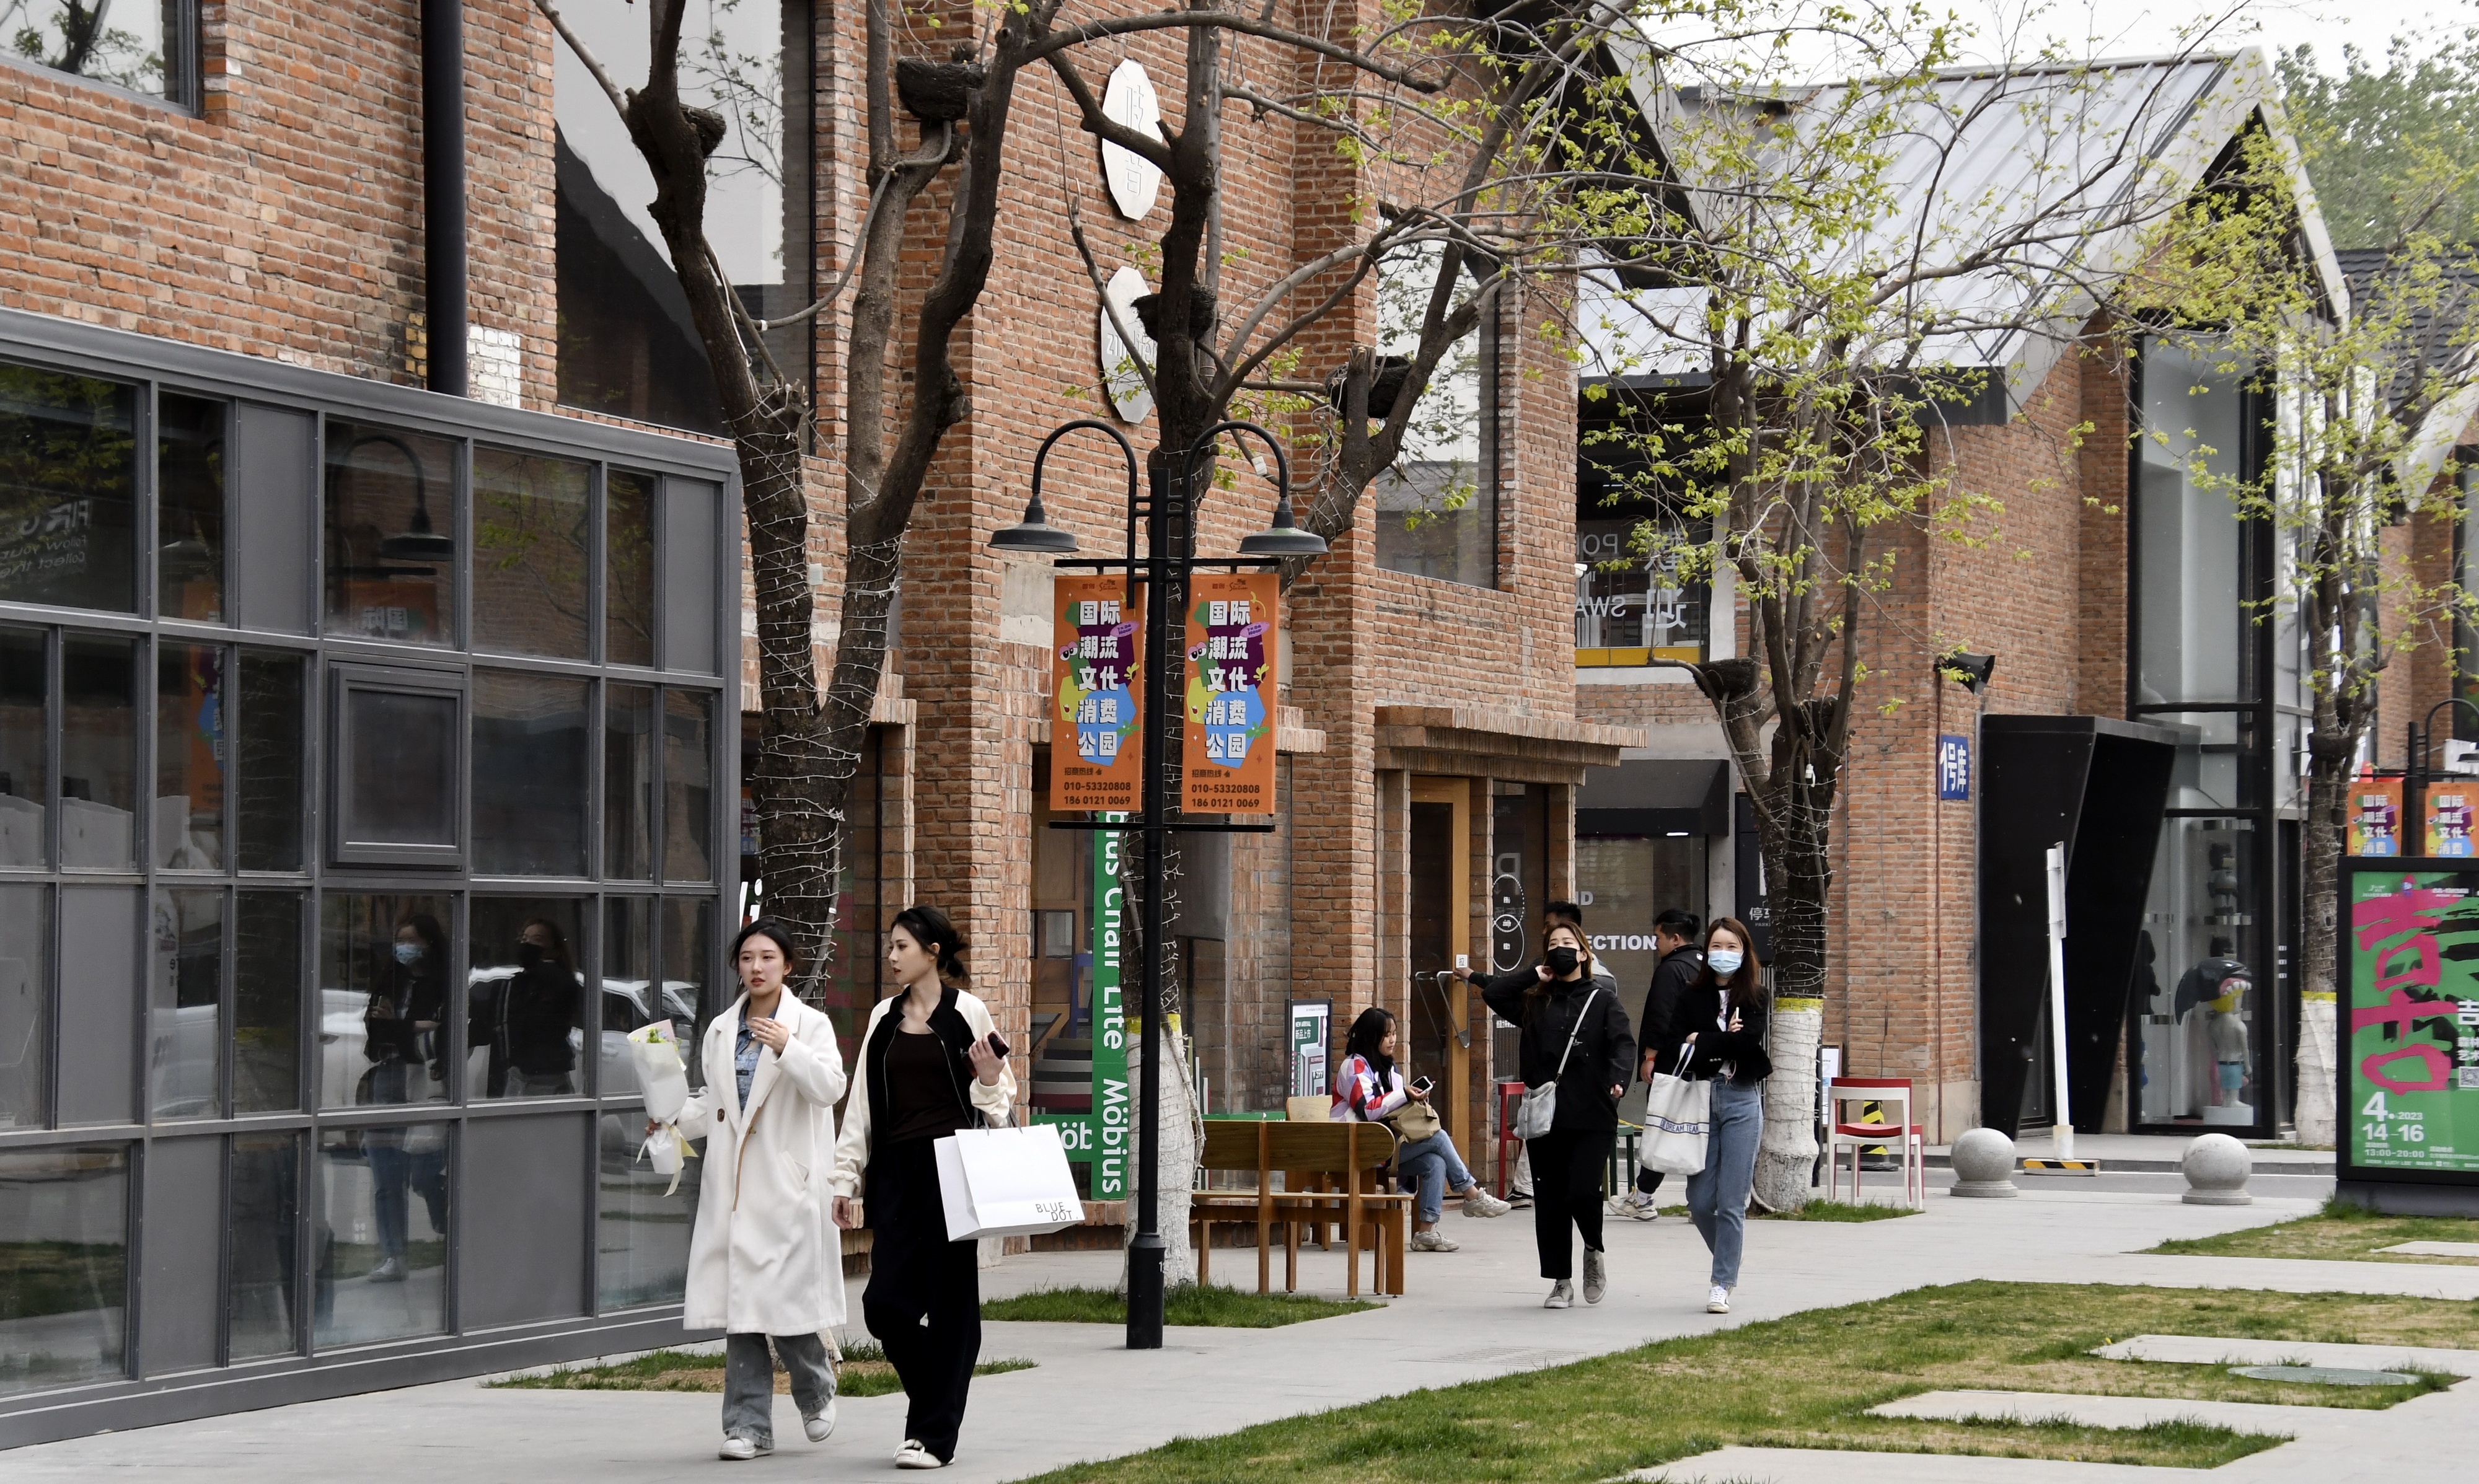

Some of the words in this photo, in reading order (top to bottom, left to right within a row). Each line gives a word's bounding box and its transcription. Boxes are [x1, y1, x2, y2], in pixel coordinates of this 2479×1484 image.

[1080, 600, 1121, 625] 国际
[1209, 600, 1250, 626] 国际
[1080, 635, 1119, 659] 潮流
[1209, 636, 1249, 660] 潮流
[1078, 665, 1119, 691] 文化
[1207, 666, 1248, 692] 文化
[1078, 698, 1117, 724] 消费
[1205, 700, 1246, 726] 消费
[1078, 731, 1117, 757] 公园
[1206, 733, 1246, 758] 公园
[1064, 781, 1131, 791] 010-53320808
[1192, 784, 1260, 794] 010-53320808
[1064, 796, 1080, 805] 186
[1083, 796, 1105, 805] 0121
[1107, 796, 1131, 805] 0069
[1192, 798, 1209, 807] 186
[1211, 798, 1233, 807] 0121
[1236, 798, 1259, 808] 0069
[2362, 826, 2387, 838] 文化
[2438, 827, 2464, 839] 文化
[1295, 1029, 1311, 1040] 新品上市
[2398, 1112, 2423, 1120] 2023
[1103, 1078, 1128, 1193] Möbius
[1036, 1202, 1065, 1213] BLUE
